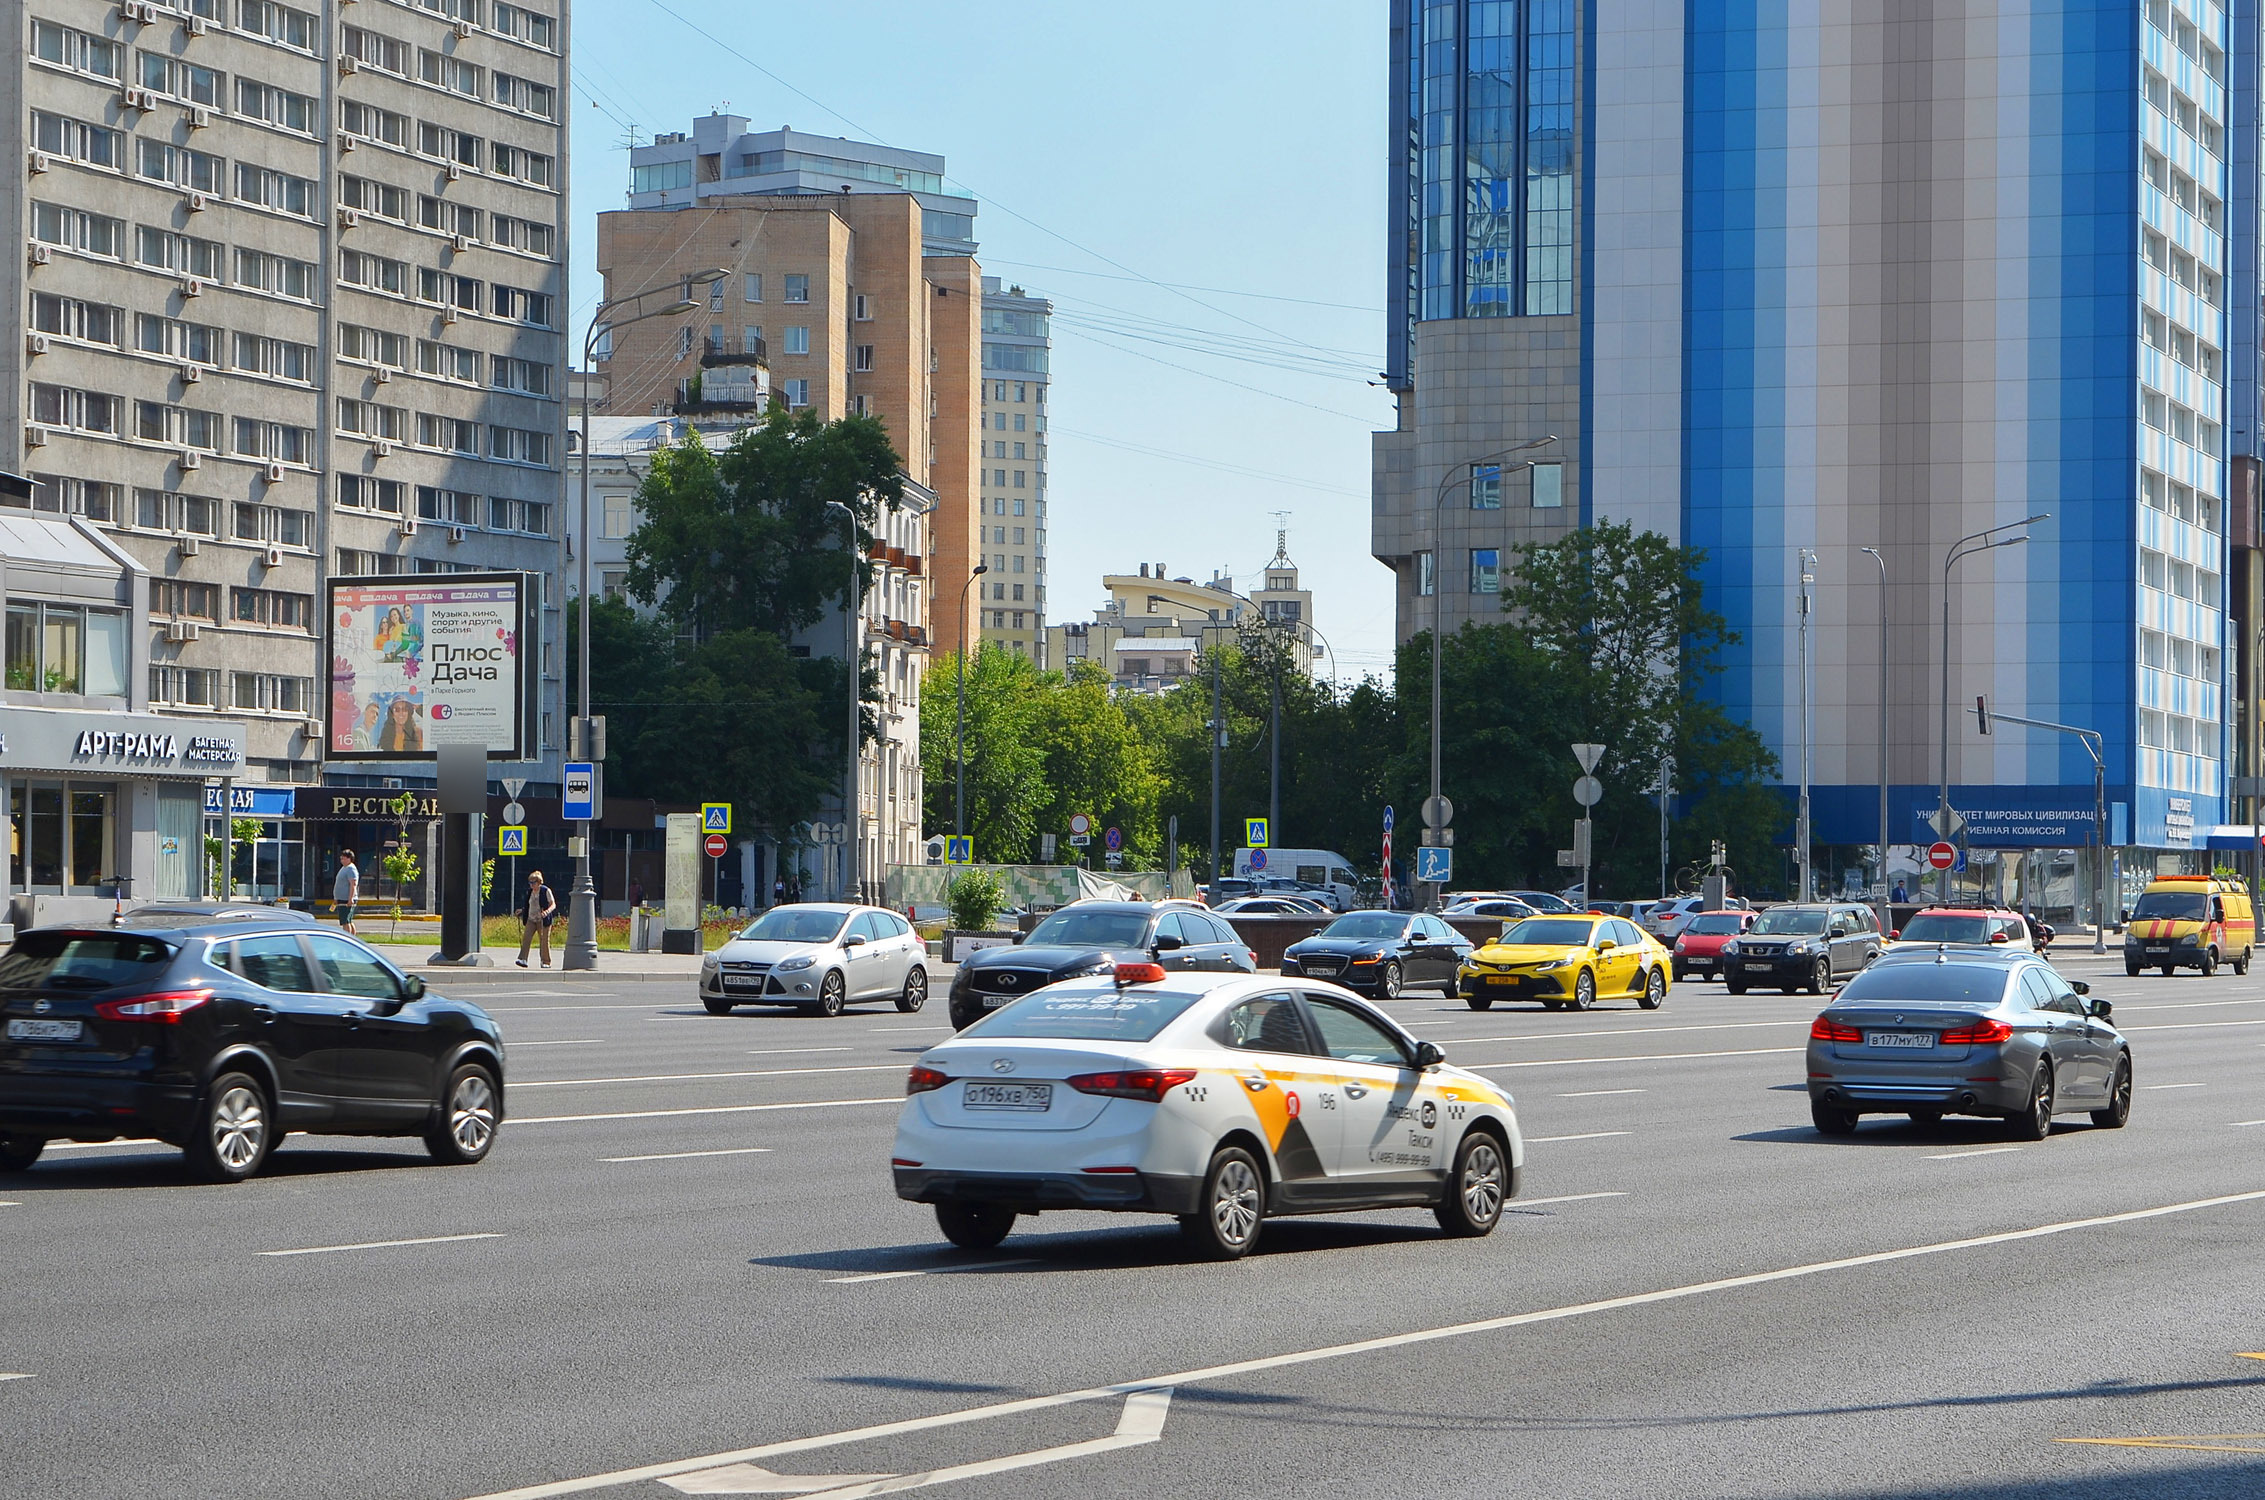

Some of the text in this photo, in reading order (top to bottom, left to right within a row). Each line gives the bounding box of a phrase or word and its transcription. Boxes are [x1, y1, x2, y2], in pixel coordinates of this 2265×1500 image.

[432, 610, 470, 618] Музыка,
[432, 618, 460, 626] спорт
[468, 618, 502, 626] другие
[432, 626, 472, 634] события
[431, 644, 502, 662] Плюс
[431, 663, 498, 685] Дача
[452, 687, 476, 695] Горького
[79, 730, 178, 759] АРТ-РАМА
[195, 736, 235, 749] БАГЕТНАЯ
[336, 734, 363, 746] 16+
[188, 748, 241, 763] МАСТЕРСКАЯ
[1985, 810, 2033, 820] МИРОВЫХ
[2012, 826, 2065, 835] КОМИССИЯ
[1872, 1035, 1930, 1046] В177МУ 177
[968, 1086, 1047, 1104] О196ХВ 750
[1319, 1092, 1336, 1111] 196
[1287, 1096, 1298, 1116] Я
[1386, 1100, 1435, 1125] Яндекс Go
[1408, 1129, 1435, 1149] Такси
[1376, 1151, 1431, 1167] (495) 999-99-99
